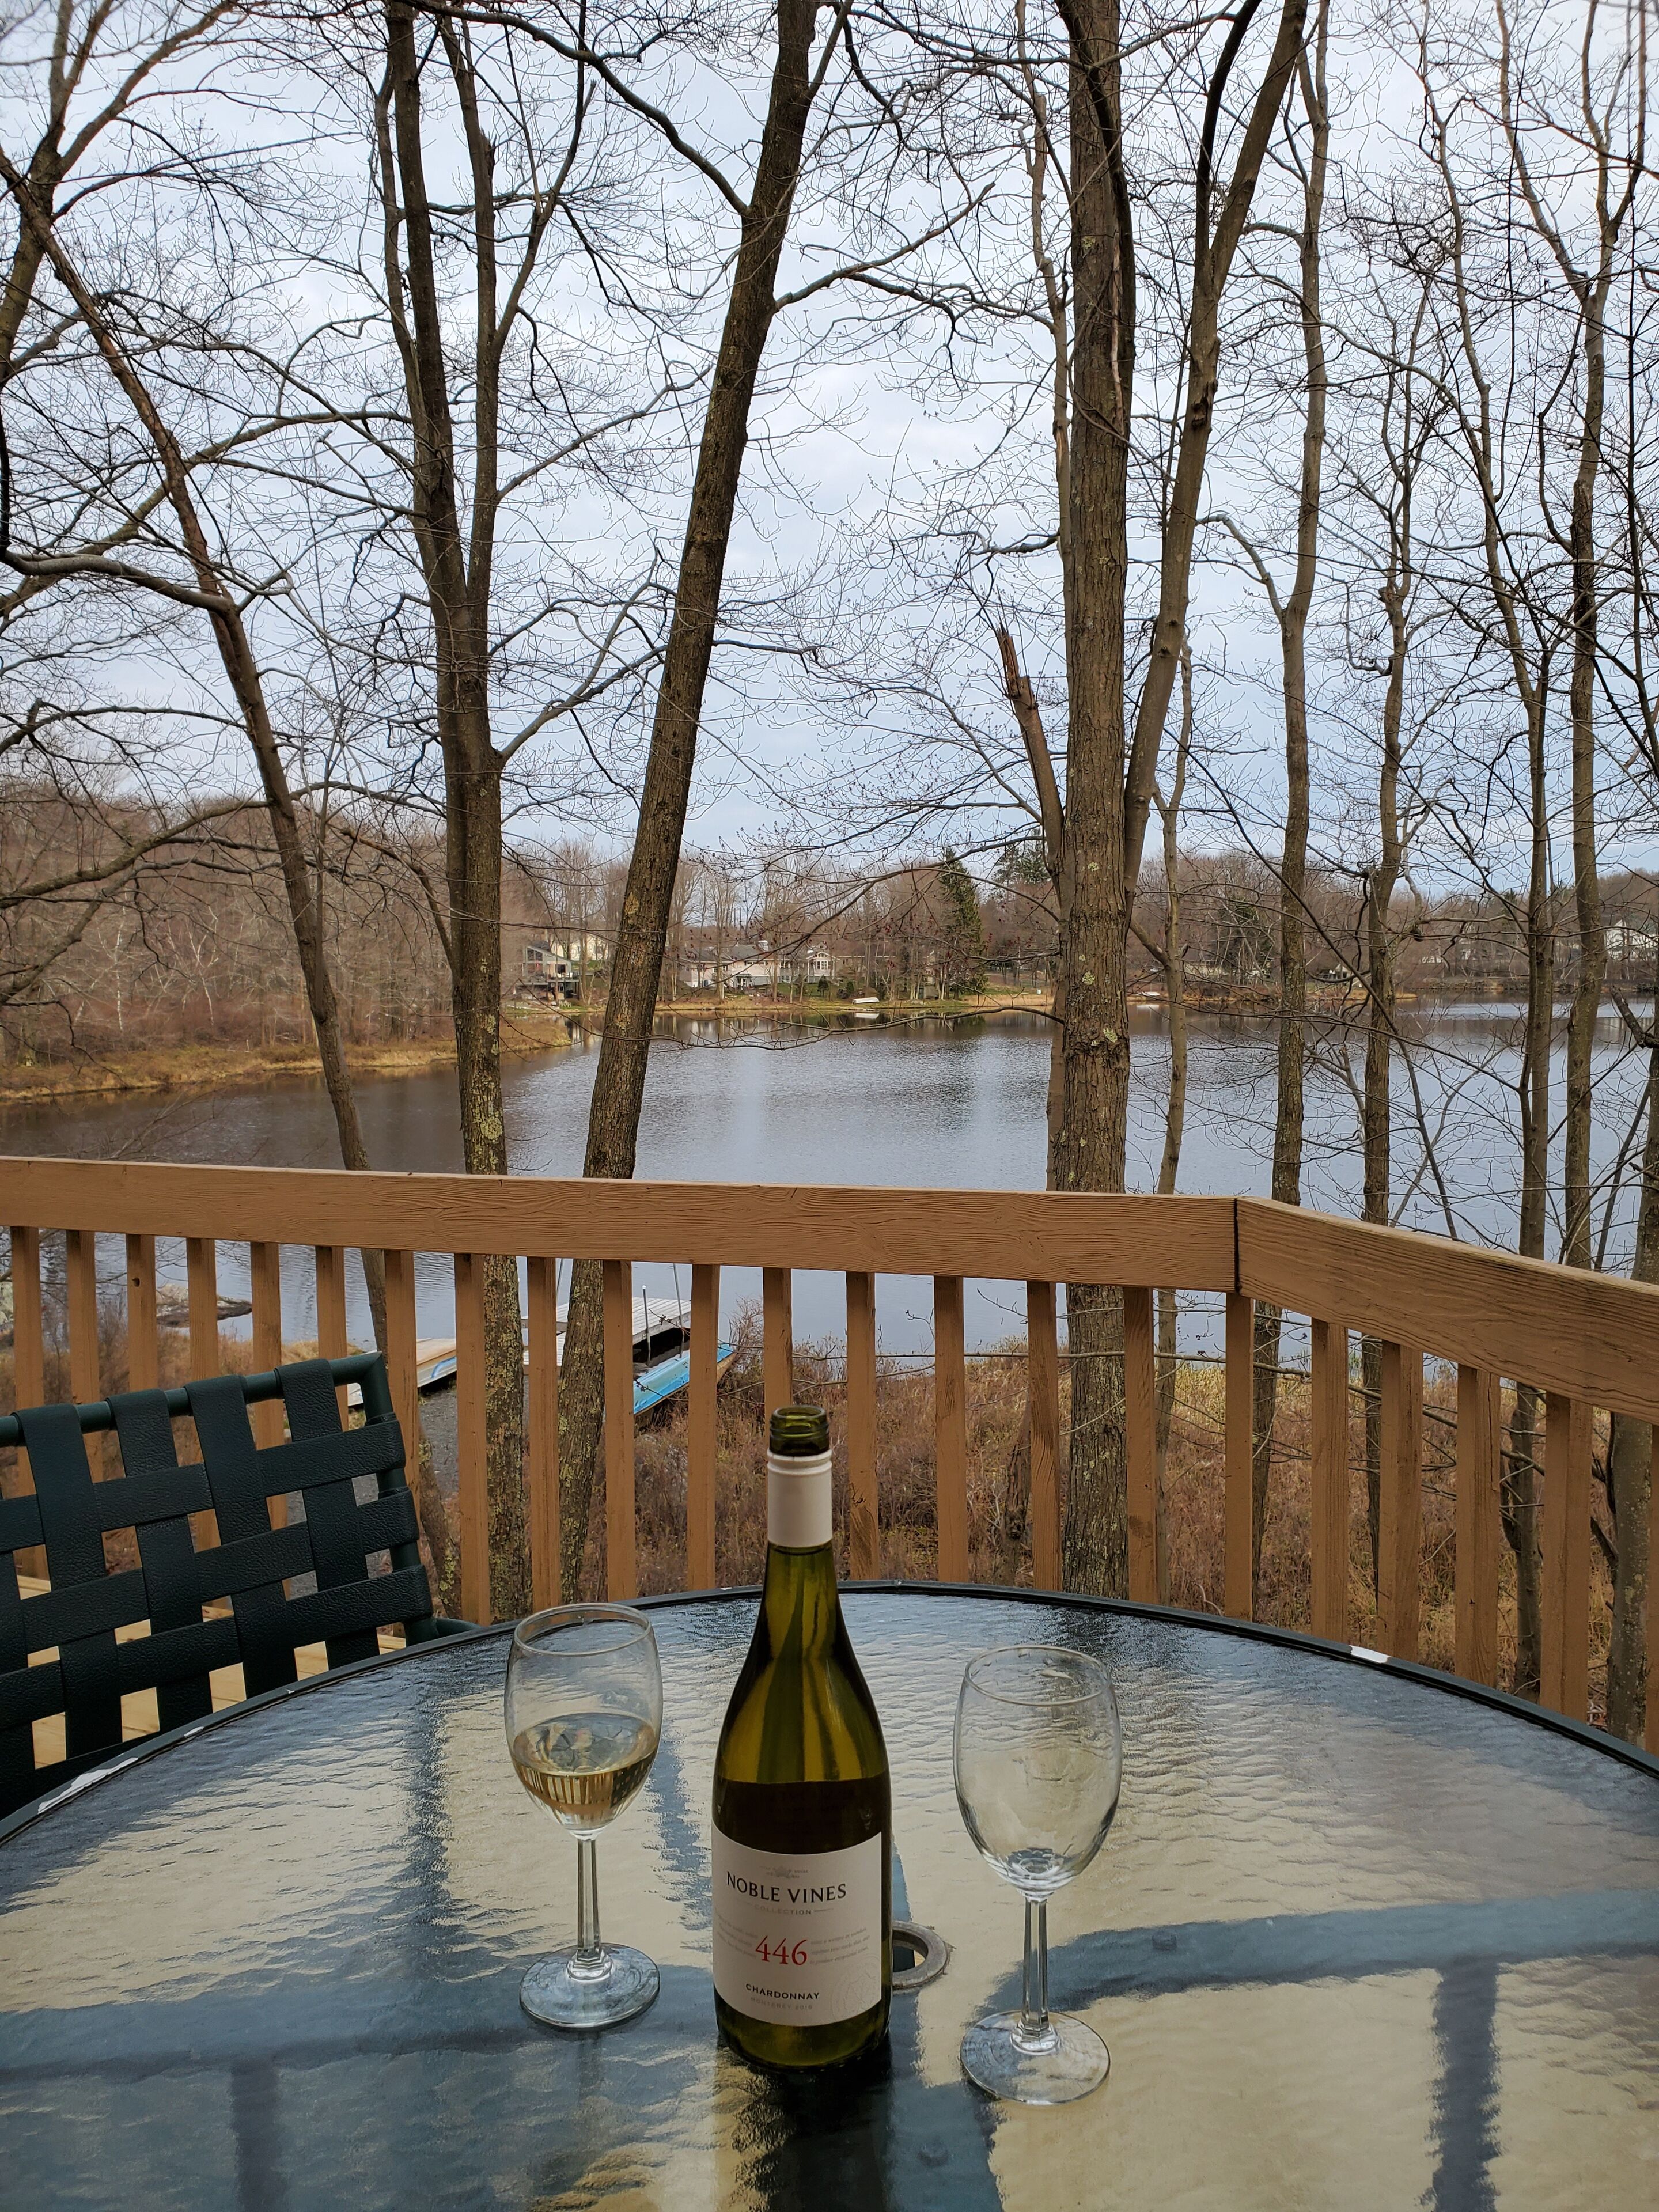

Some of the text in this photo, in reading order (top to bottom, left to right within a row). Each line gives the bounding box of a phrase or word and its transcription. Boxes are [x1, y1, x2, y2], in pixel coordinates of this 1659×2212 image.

[727, 1871, 780, 1902] NOBLE
[787, 1883, 846, 1903] VINES
[755, 1904, 812, 1915] COLLECTION
[755, 1935, 808, 1965] 446
[745, 1983, 820, 2000] CHARDONNAY
